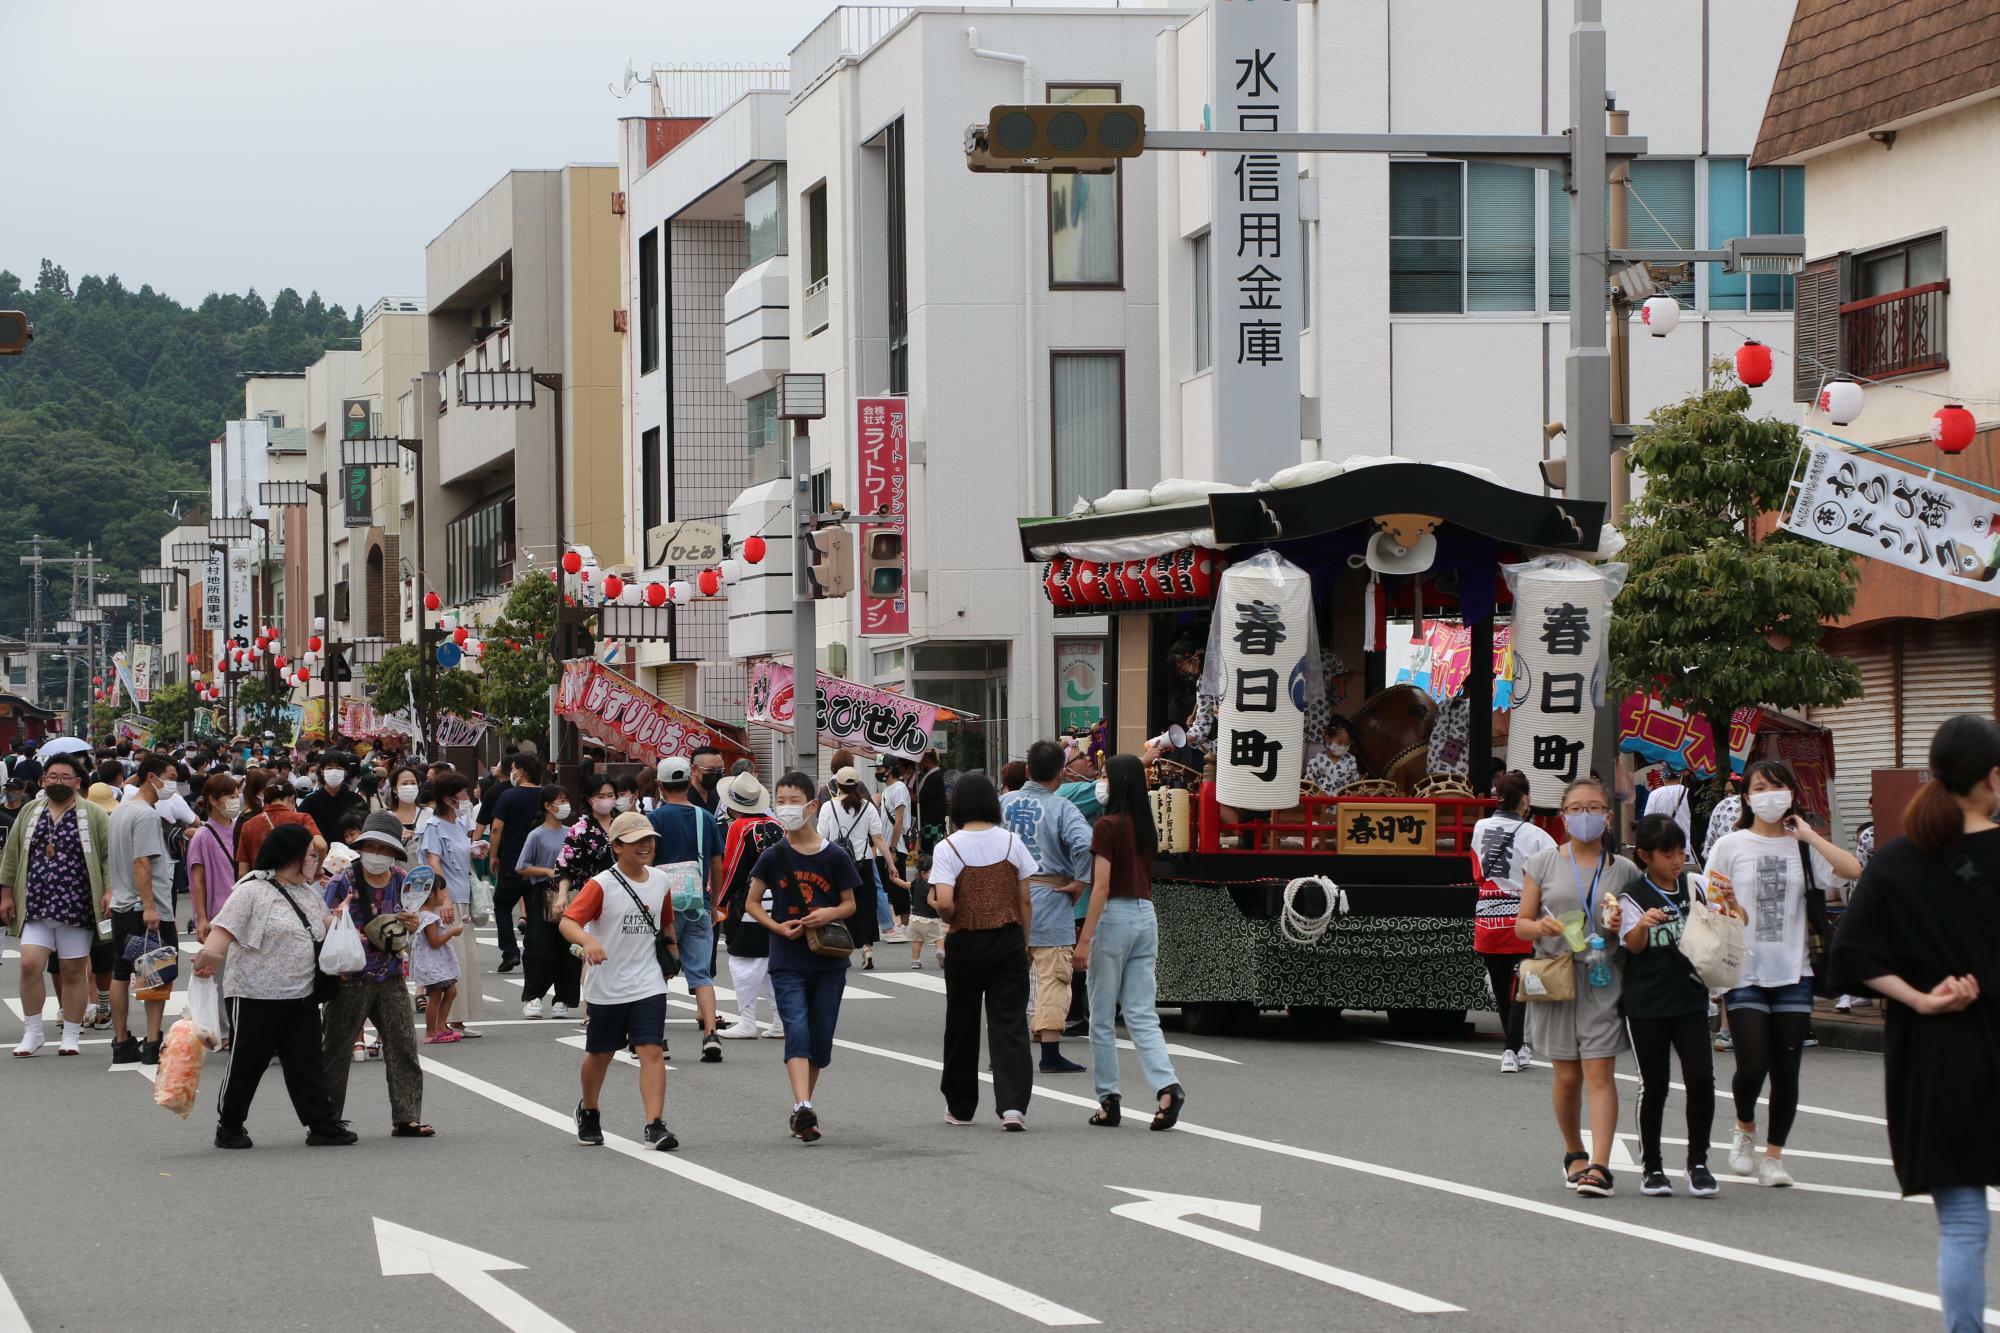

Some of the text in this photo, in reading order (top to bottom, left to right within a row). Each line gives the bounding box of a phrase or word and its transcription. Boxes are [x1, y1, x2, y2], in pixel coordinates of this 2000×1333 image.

[1234, 48, 1284, 367] 水戸信用金庫
[1826, 461, 1953, 529] わらび餅
[670, 545, 717, 561] ひとみ
[1847, 507, 1960, 575] ドリンク
[585, 674, 711, 758] けずりいちご
[1230, 599, 1287, 783] 春日町
[1532, 602, 1591, 784] 春日町
[1346, 812, 1428, 846] 春日町
